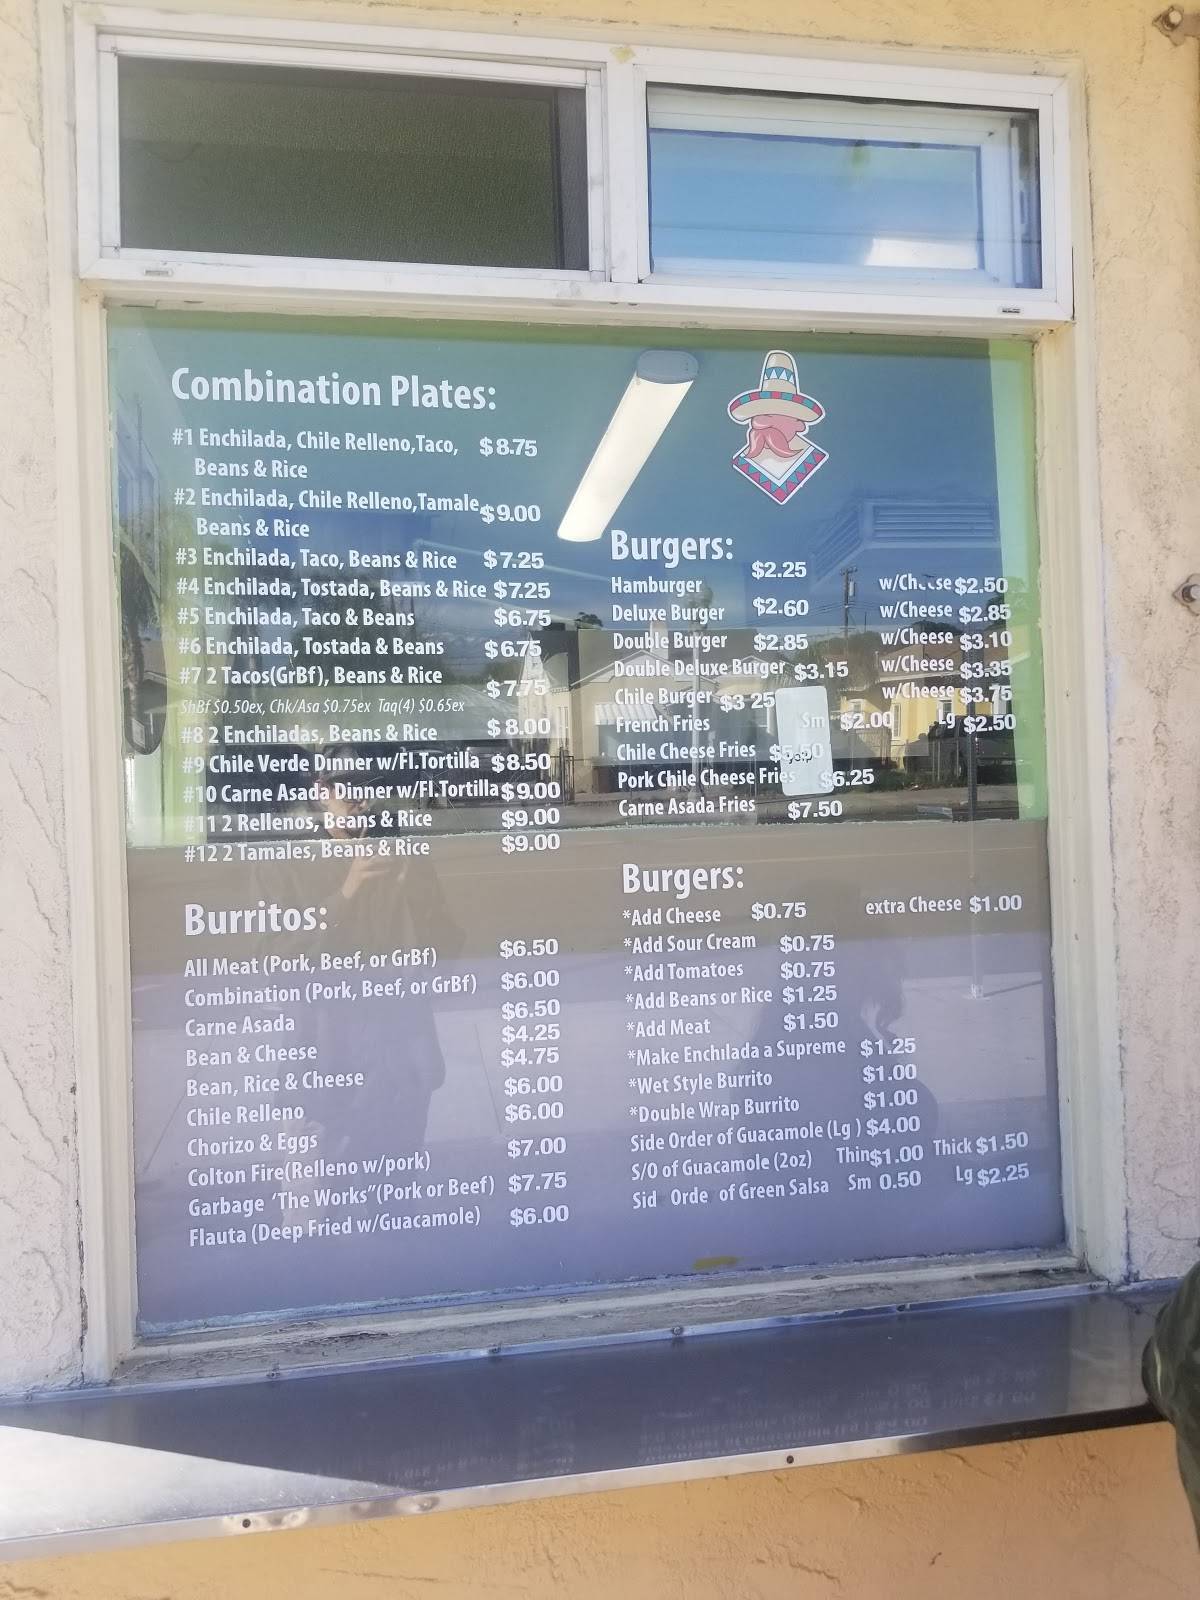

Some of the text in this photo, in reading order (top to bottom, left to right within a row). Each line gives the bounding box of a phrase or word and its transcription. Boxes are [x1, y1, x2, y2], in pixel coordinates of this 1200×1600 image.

[171, 367, 496, 410] Combination Plates:
[172, 429, 193, 447] #1
[199, 429, 292, 451] Enchilada,
[297, 432, 340, 450] Chile
[345, 433, 458, 455] Relleno,Taco,
[174, 489, 195, 506] #2
[201, 488, 294, 511] Enchilada,
[298, 490, 342, 509] Chile
[176, 549, 197, 566] #3
[203, 548, 296, 570] Enchilada,
[300, 549, 344, 571] Taco,
[349, 550, 401, 568] Beans
[405, 551, 419, 569] &
[424, 551, 457, 569] Rice
[611, 529, 733, 568] Burgers:
[176, 579, 199, 594] #4
[204, 578, 297, 600] Enchilada,
[301, 579, 375, 601] Tostada,
[380, 580, 431, 598] Beans
[436, 580, 449, 598] &
[453, 580, 486, 598] Rice
[611, 575, 702, 597] Hamburger
[752, 561, 807, 579] $2.25
[954, 577, 1008, 595] $2.50
[177, 607, 551, 630] #5 Enchilada, Taco & Beans $6.75
[612, 597, 1011, 624] Deluxe Burger $2.60 w/Cheese $2.85
[180, 667, 202, 684] #7
[207, 667, 217, 683] 2
[222, 666, 329, 687] Tacos(GrBf),
[334, 667, 386, 684] Beans
[391, 667, 403, 684] &
[408, 667, 443, 684] Rice
[614, 654, 1012, 682] Double Deluxe Burger $3.15 w/Cheese $3.35
[213, 699, 265, 716] $0.50ex,
[270, 698, 320, 715] Chk/Asa
[323, 699, 370, 714] $0.75ex
[378, 698, 414, 716] Taq(4)
[419, 698, 465, 713] $0.65ex
[616, 714, 669, 733] French
[674, 714, 710, 731] Fries
[840, 711, 893, 731] $2.00
[938, 710, 955, 729] Lg
[964, 712, 1016, 733] $2.50
[182, 757, 204, 773] #9
[209, 755, 254, 773] Chile
[258, 754, 309, 772] Verde
[314, 754, 373, 772] Dinner
[377, 752, 479, 771] w/Fl.Tortilla
[183, 787, 217, 804] #10
[222, 784, 273, 802] Carne
[277, 784, 329, 801] Asada
[335, 781, 392, 800] Dinner
[397, 779, 498, 799] w/Fl.Tortilla
[618, 767, 874, 789] Pork Chile Cheese Fries $6.25
[619, 796, 843, 819] Carne Asada Fries $7.50
[623, 863, 744, 898] Burgers:
[184, 901, 328, 936] Burritos:
[666, 906, 721, 924] Cheese
[751, 901, 806, 921] $0.75
[866, 898, 906, 915] extra
[909, 896, 962, 914] Cheese
[970, 895, 1022, 913] $1.00
[184, 938, 559, 977] All Meat (Pork, Beef, or GrBf) $6.50
[667, 935, 703, 952] Sour
[706, 933, 756, 952] Cream
[780, 934, 835, 954] $0.75
[186, 999, 560, 1036] Carne Asada $6.50
[186, 1023, 560, 1066] Bean & Cheese $4.25
[684, 1041, 760, 1064] Enchilada
[764, 1043, 772, 1058] a
[777, 1038, 845, 1060] Supreme
[860, 1037, 916, 1058] $1.25
[186, 1076, 563, 1127] Chile Relleno $6.00
[187, 1102, 563, 1157] Chorizo & Eggs $6.00
[188, 1167, 246, 1187] Colton
[362, 1151, 431, 1175] w/pork)
[507, 1137, 566, 1158] $7.00
[662, 1156, 679, 1179] of
[682, 1153, 770, 1177] Guacamole
[774, 1150, 812, 1172] (2oz)
[836, 1145, 870, 1165] Thin
[870, 1144, 924, 1167] $1.00
[933, 1137, 972, 1157] Thick
[976, 1131, 1028, 1156] $1.50
[189, 1197, 265, 1219] Garbage
[427, 1180, 443, 1196] or
[448, 1175, 495, 1196] Beef)
[508, 1172, 567, 1193] $7.75
[190, 1205, 569, 1247] Flauta (Deep Fried w/Guacamole) $6.00
